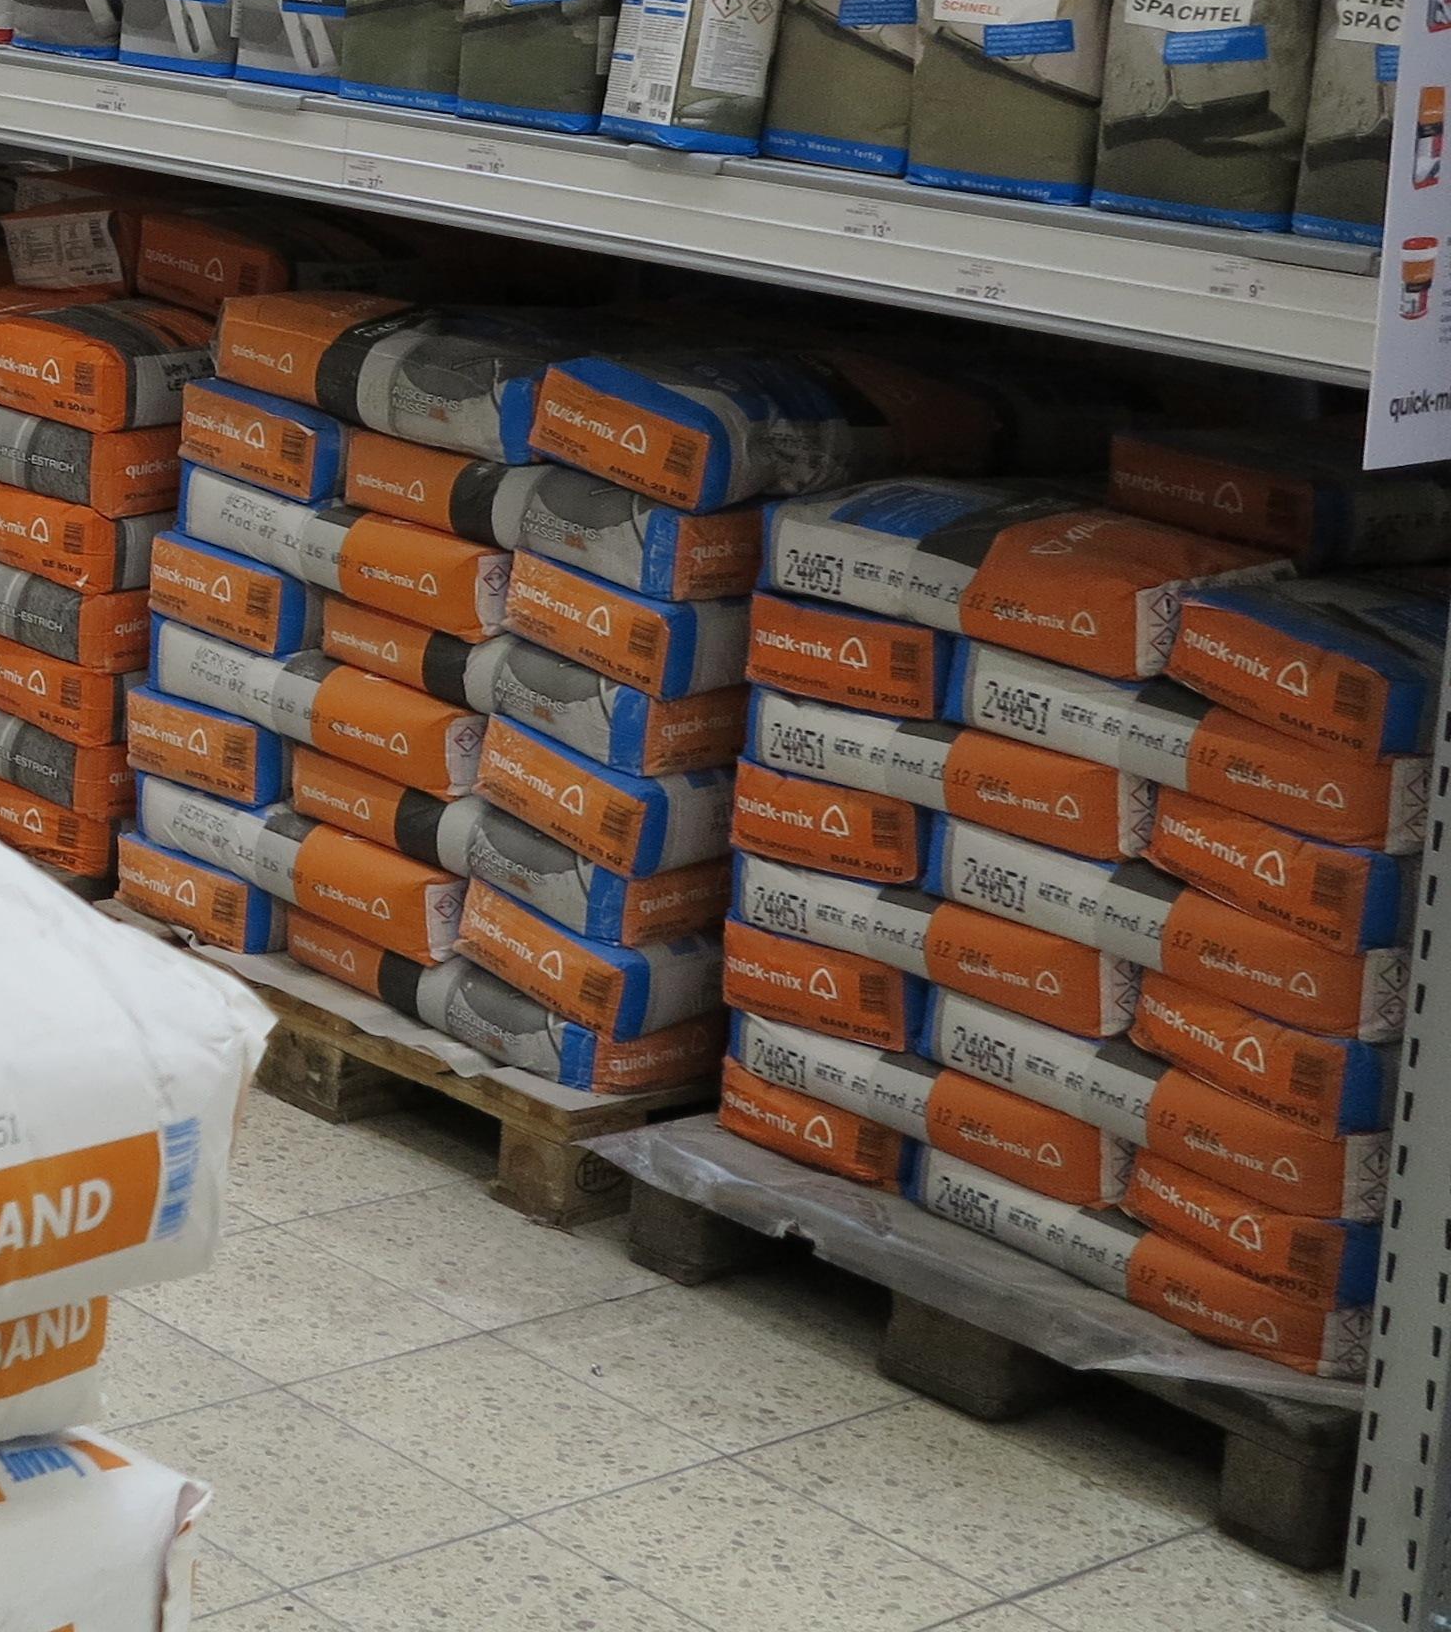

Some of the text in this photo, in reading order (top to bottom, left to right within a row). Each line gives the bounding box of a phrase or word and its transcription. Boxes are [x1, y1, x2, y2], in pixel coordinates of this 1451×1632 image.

[940, 0, 1004, 17] SCHNELL
[184, 409, 242, 439] quick-mix
[544, 397, 616, 441] quick-mix
[783, 548, 843, 596] 24051
[754, 629, 834, 662] quick-mix
